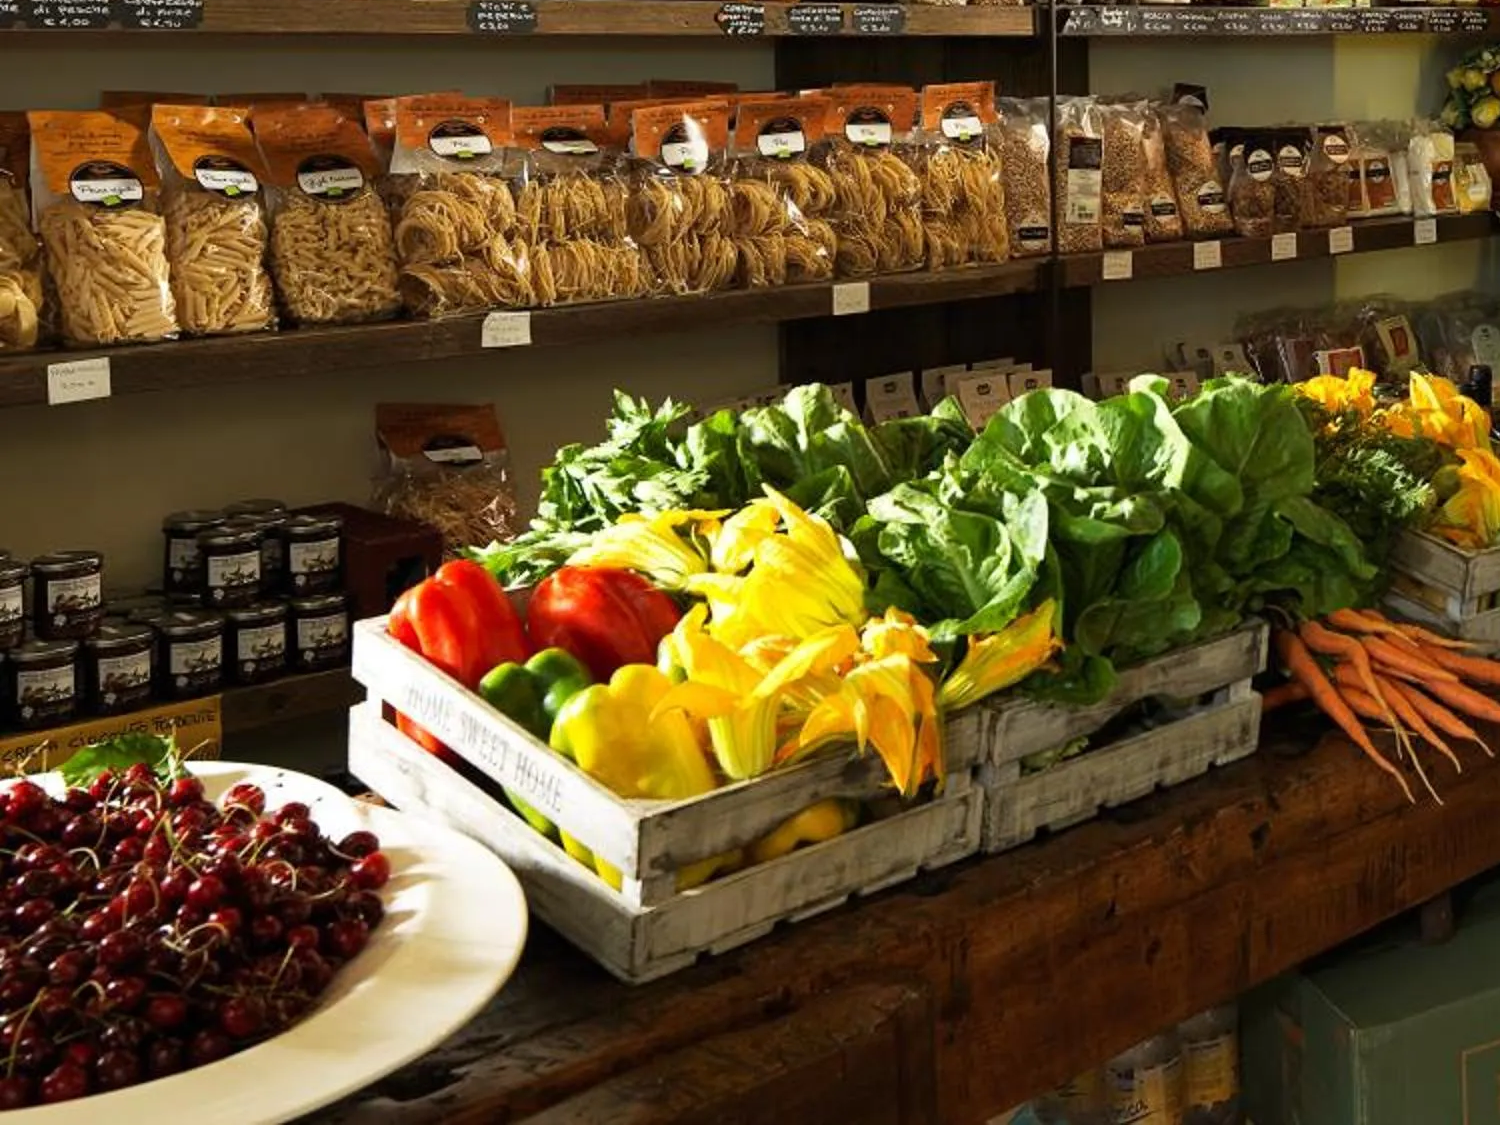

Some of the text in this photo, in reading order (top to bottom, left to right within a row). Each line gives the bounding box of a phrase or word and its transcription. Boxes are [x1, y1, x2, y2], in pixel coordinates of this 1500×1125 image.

[406, 685, 564, 815] HOME SWEET HOME
